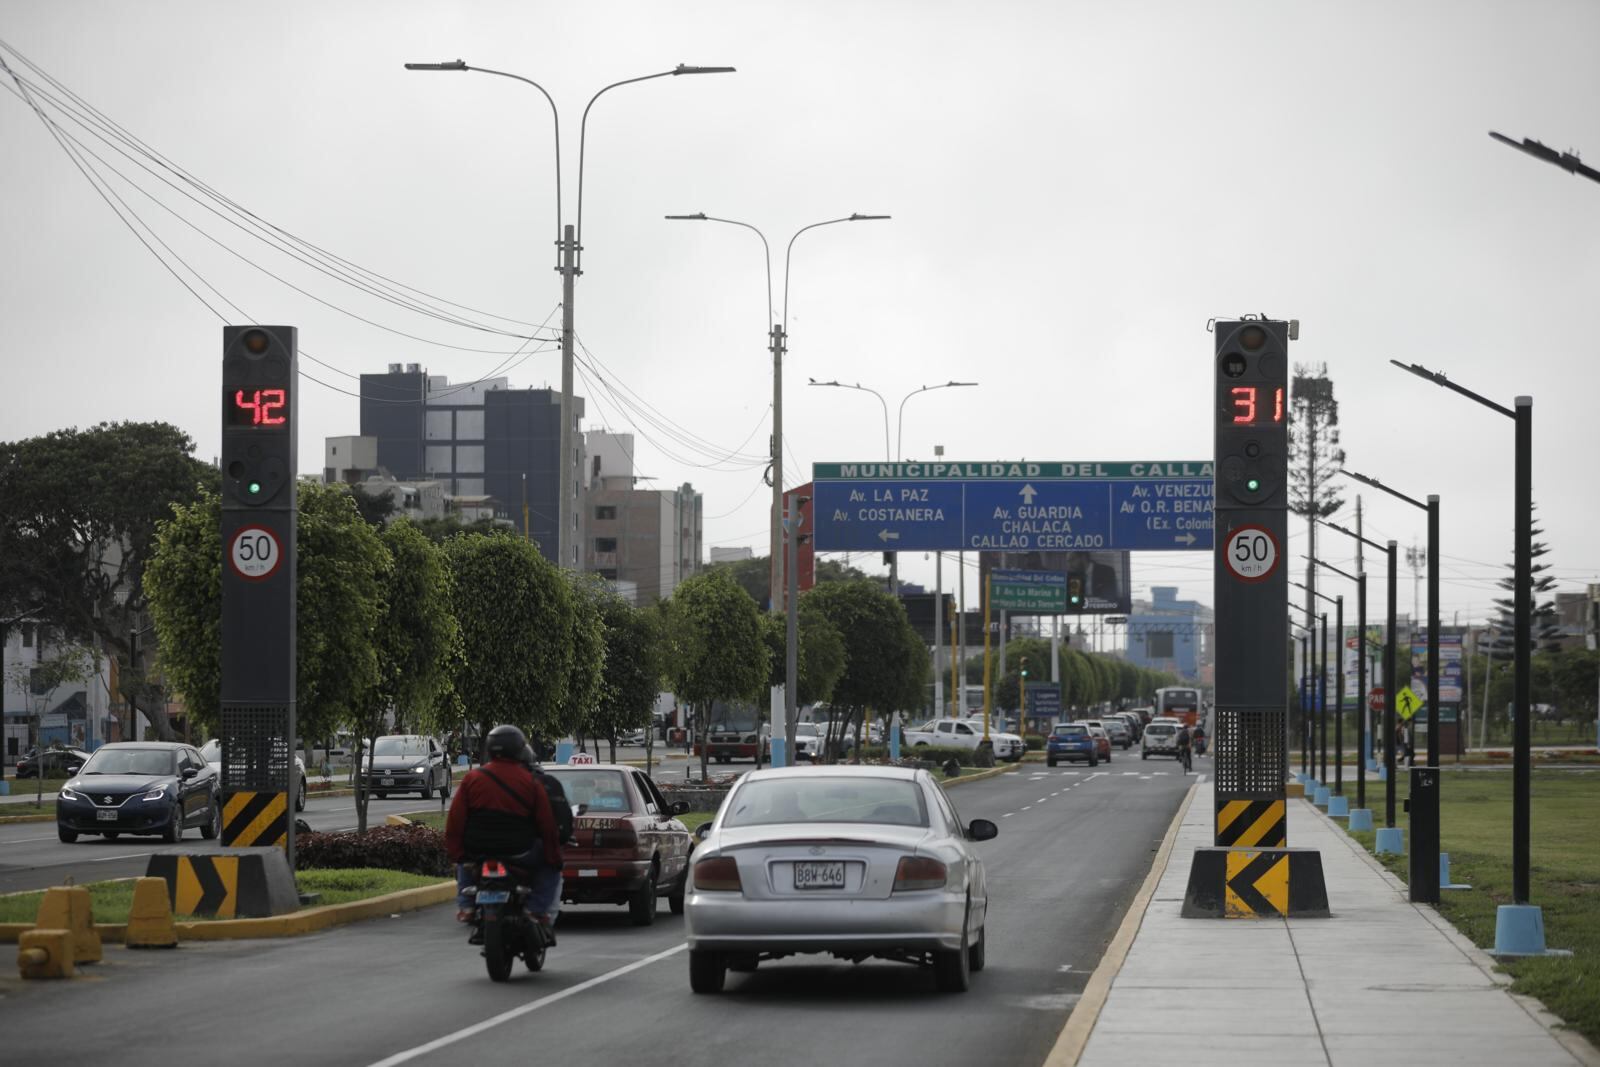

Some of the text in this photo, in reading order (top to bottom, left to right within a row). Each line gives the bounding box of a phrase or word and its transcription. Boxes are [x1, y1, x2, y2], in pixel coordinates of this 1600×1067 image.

[235, 389, 285, 424] 42
[1231, 387, 1283, 422] 31
[840, 463, 1041, 477] MUNICIPALIDAD
[1061, 463, 1108, 476] DEL
[849, 489, 929, 502] Av. LA PAZ
[1131, 485, 1151, 497] Av.
[833, 508, 945, 521] Av. COSTANERA
[993, 506, 1083, 519] Av. GUARDIA
[1002, 521, 1072, 533] CHALACA
[971, 535, 1104, 548] CALLAO CERCADO
[239, 536, 271, 561] 50
[1235, 536, 1268, 561] 50
[797, 868, 842, 882] B8W-646
